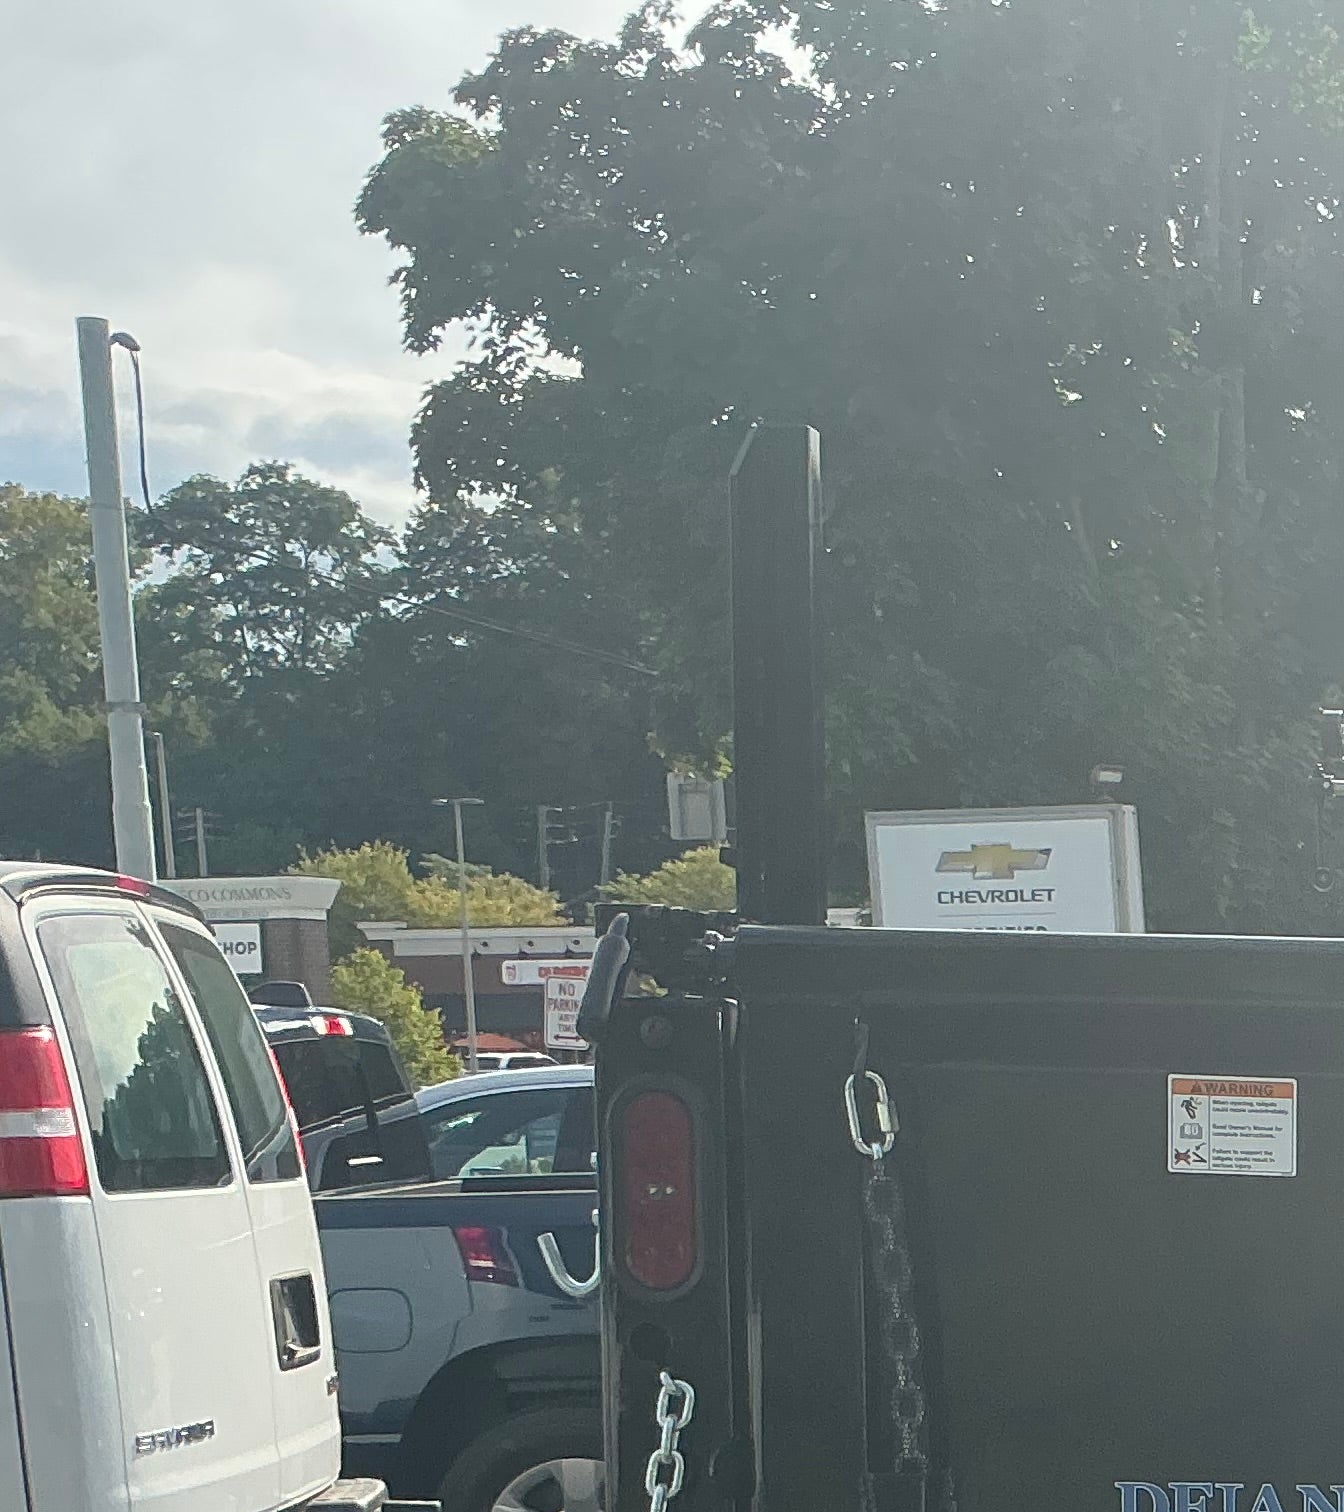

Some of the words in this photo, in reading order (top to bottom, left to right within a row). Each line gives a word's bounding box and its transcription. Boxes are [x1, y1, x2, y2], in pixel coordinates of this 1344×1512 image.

[937, 888, 1056, 904] CHEVROLET
[218, 941, 257, 955] HOP
[558, 983, 575, 996] NO
[547, 998, 580, 1012] PARKIN
[1205, 1083, 1274, 1096] WARNING
